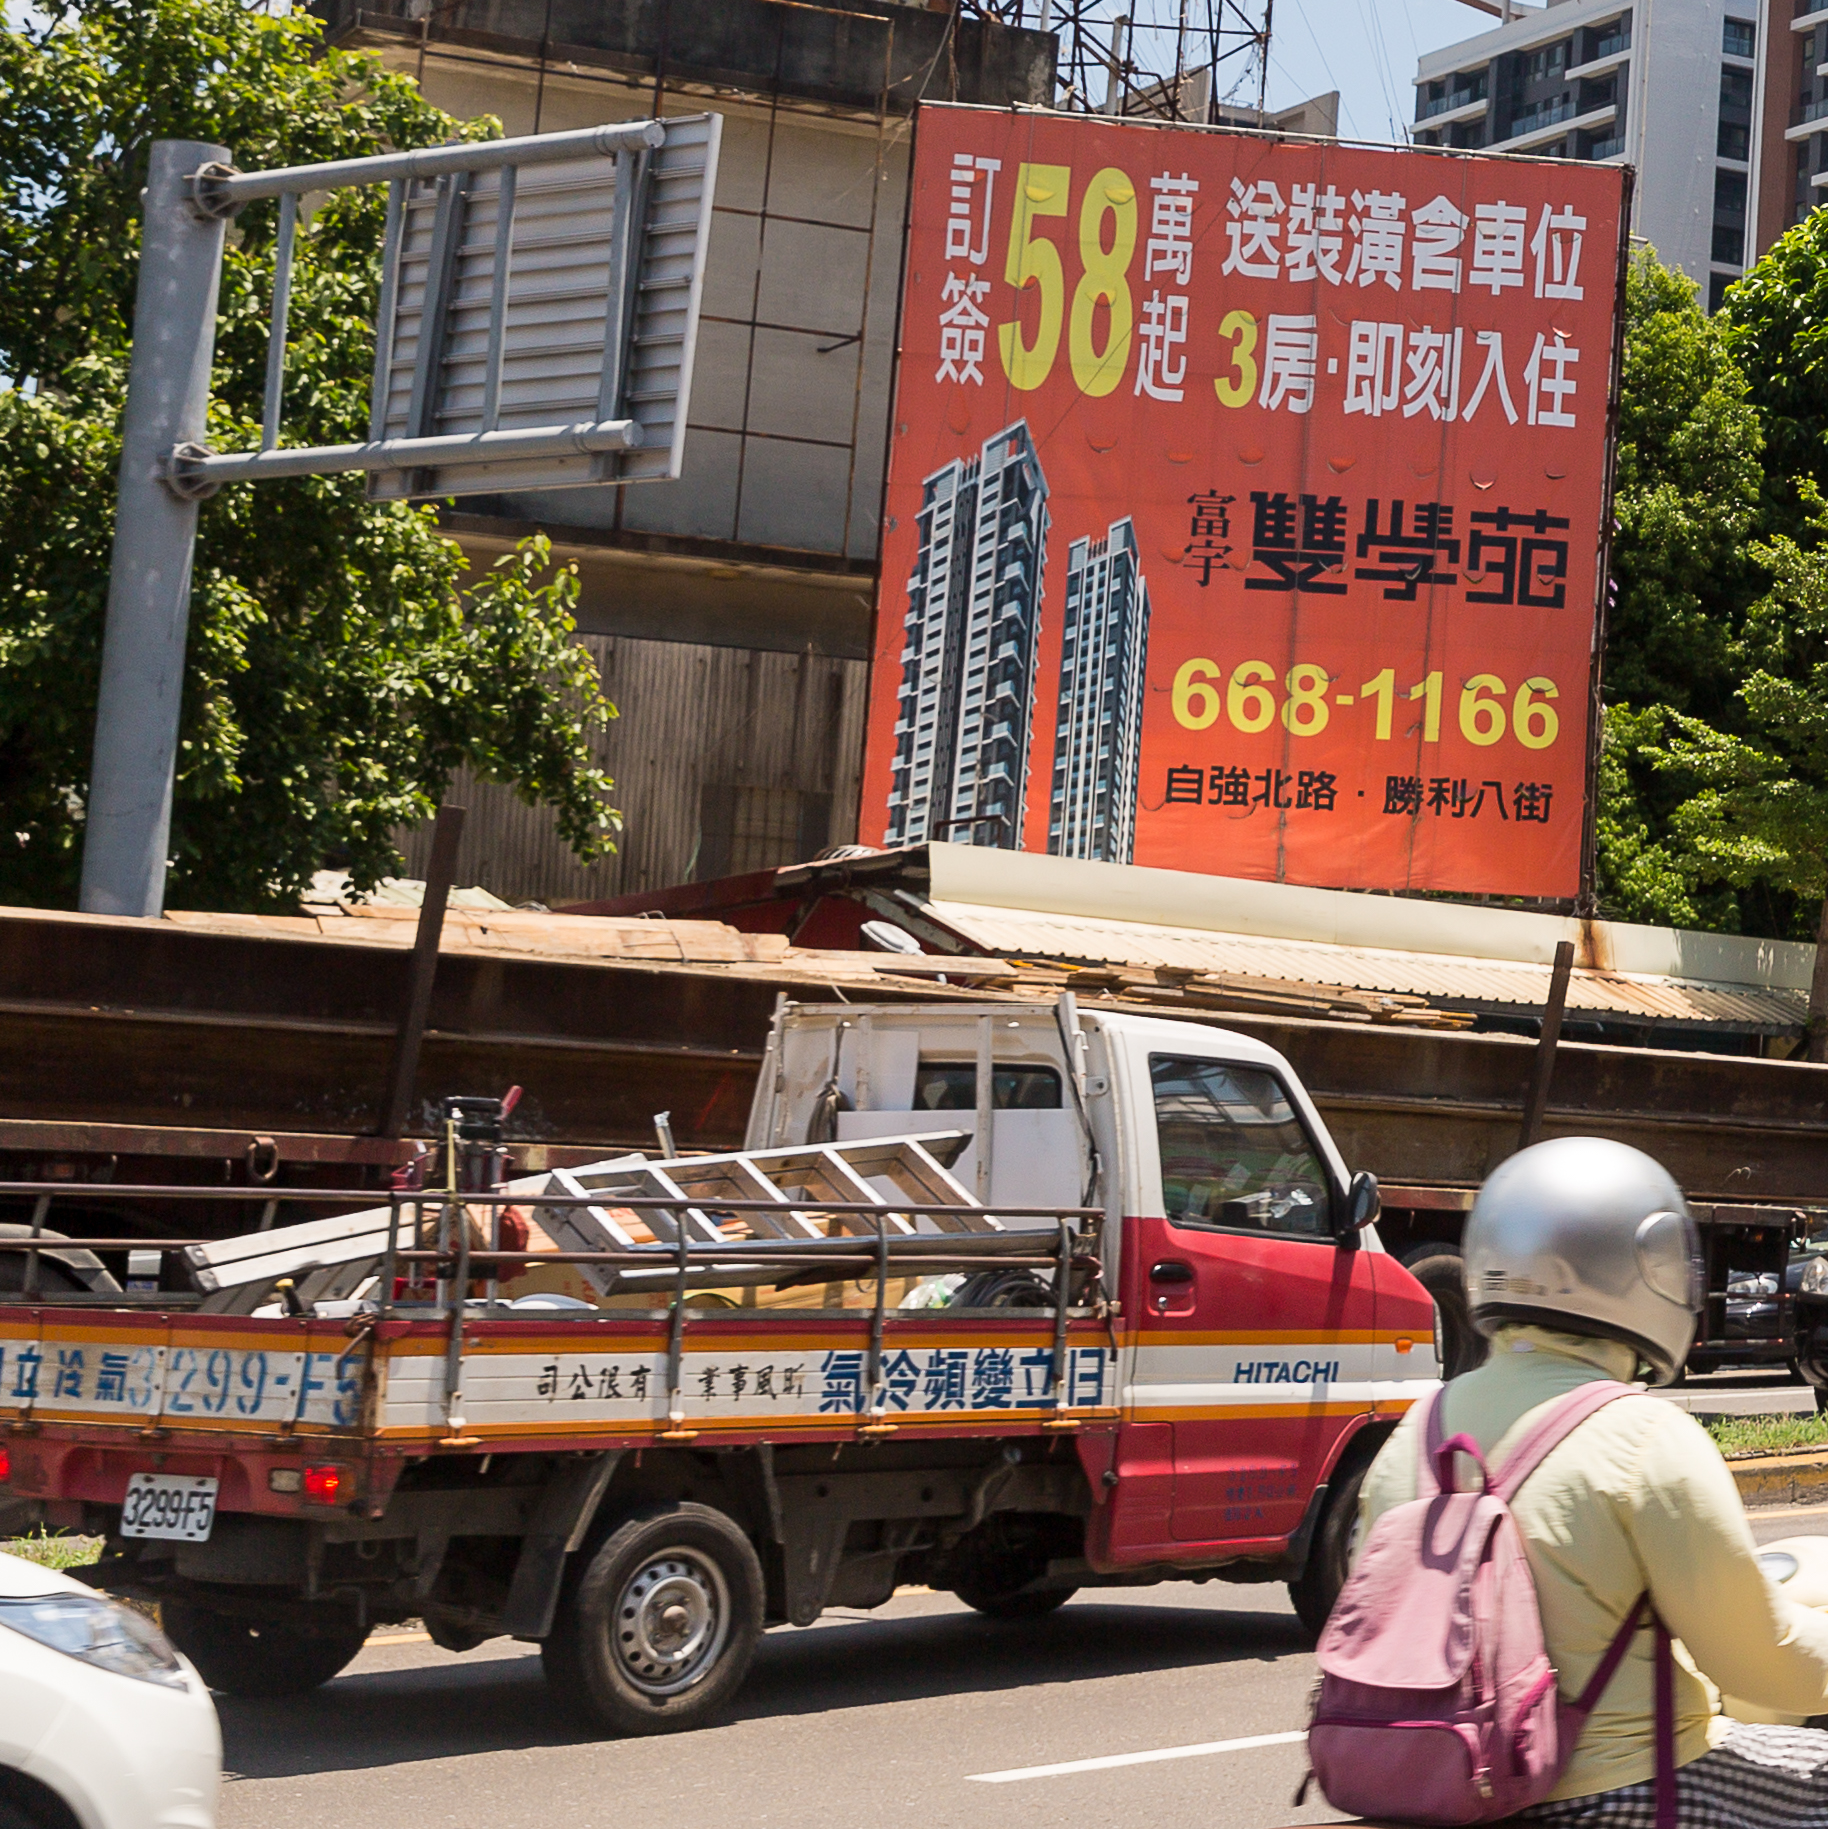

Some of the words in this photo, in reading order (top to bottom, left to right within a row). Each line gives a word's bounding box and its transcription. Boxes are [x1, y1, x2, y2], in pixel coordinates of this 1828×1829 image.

[998, 164, 1137, 397] 58
[1222, 176, 1587, 301] 送裝潢含車位
[1183, 489, 1237, 589] 富宇
[1245, 492, 1569, 609] 雙學苑
[1171, 656, 1560, 750] 668-1166
[0, 1345, 129, 1402] 立冷氣
[1233, 1361, 1339, 1385] HITACHI
[124, 1487, 215, 1531] 3299-F5
